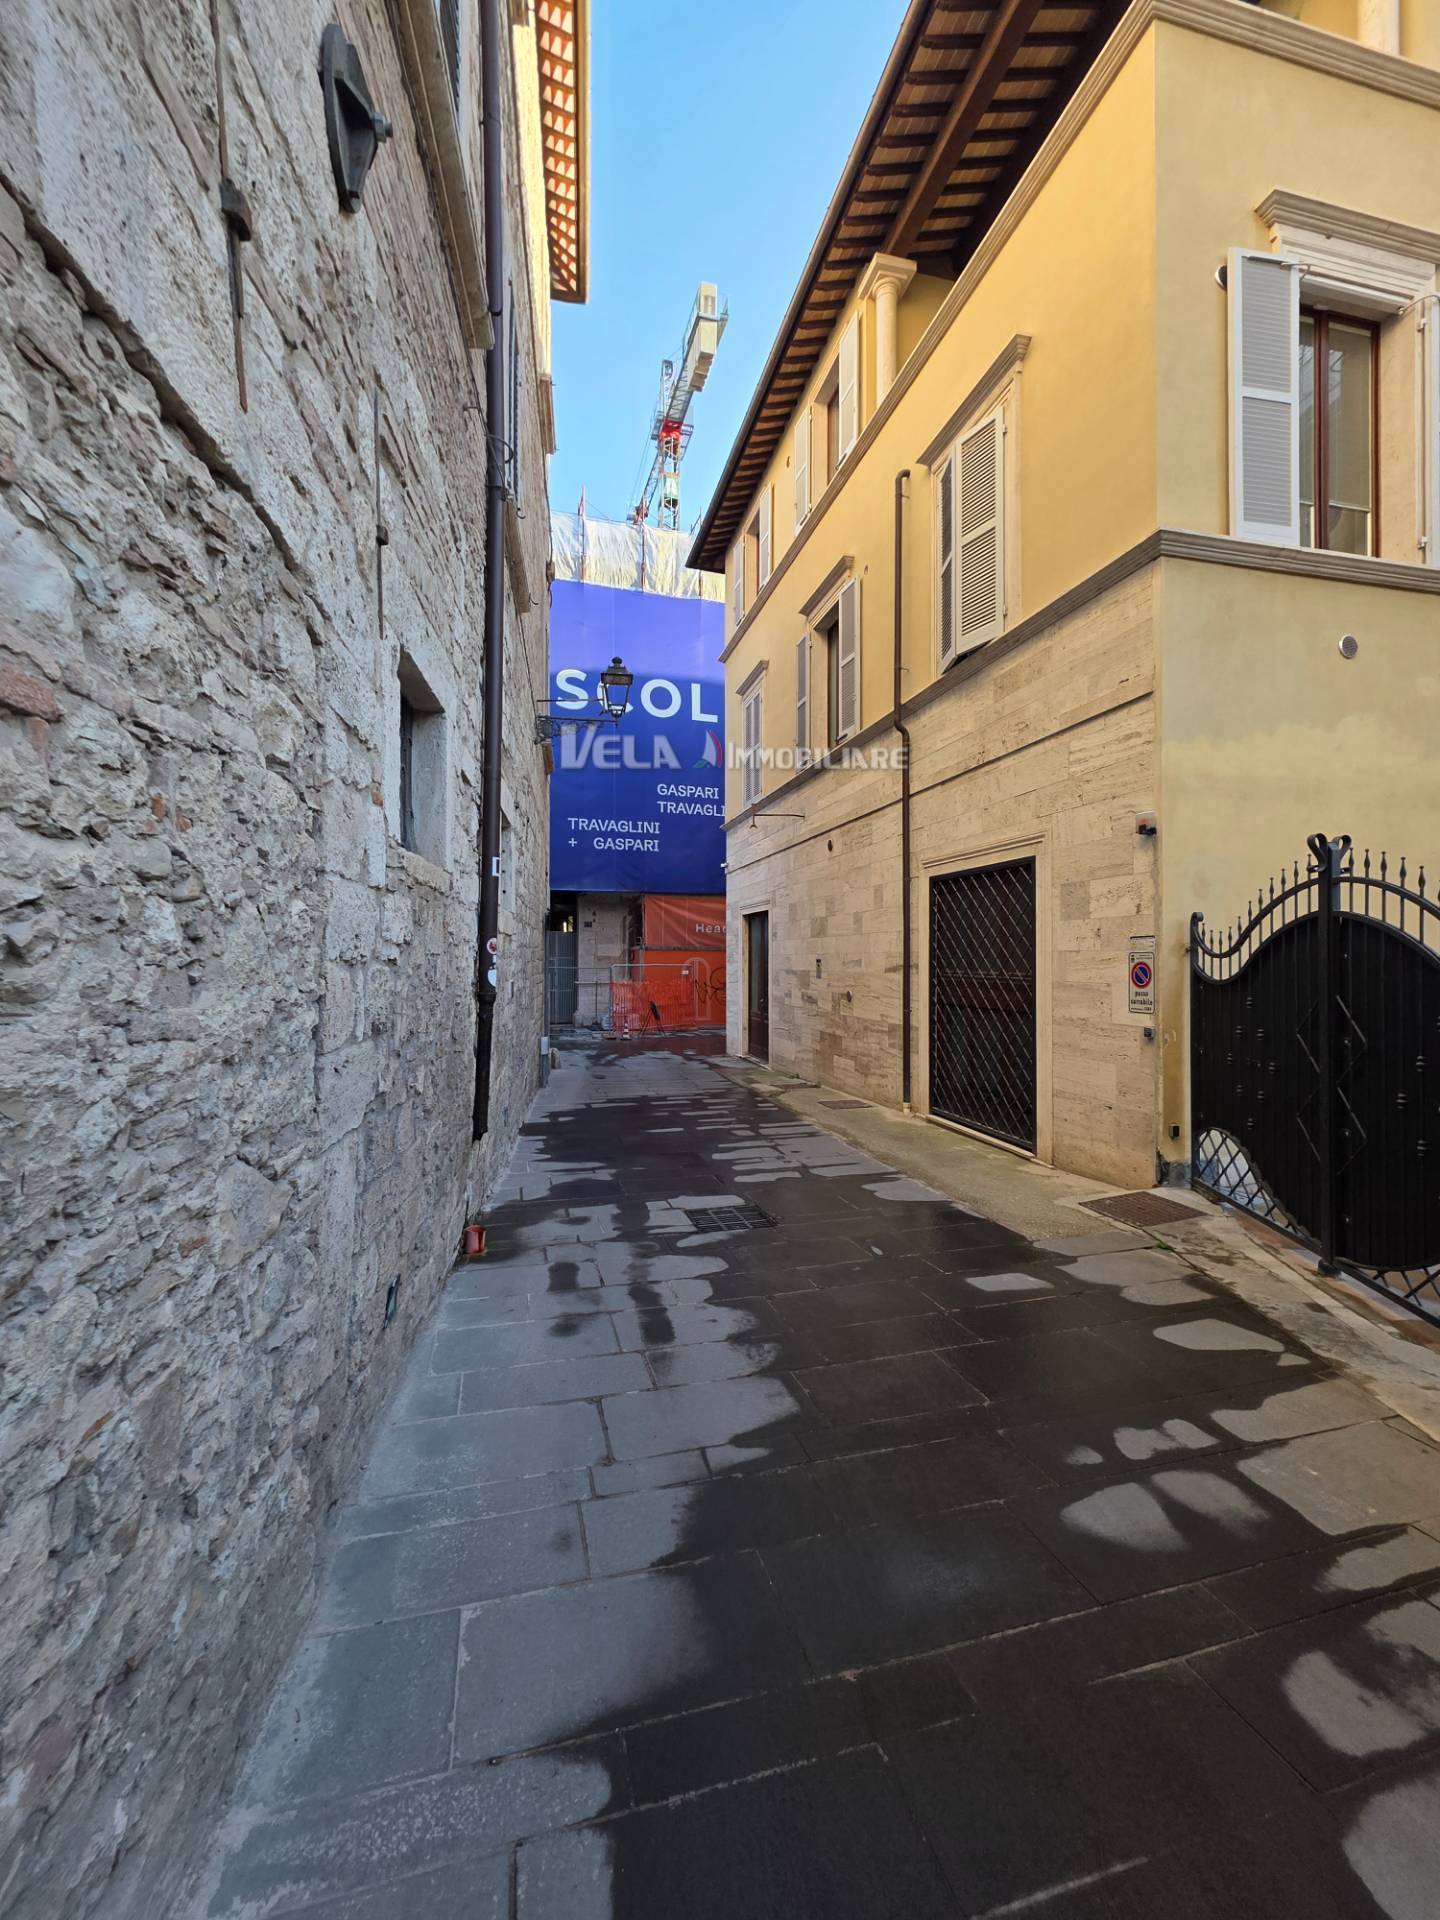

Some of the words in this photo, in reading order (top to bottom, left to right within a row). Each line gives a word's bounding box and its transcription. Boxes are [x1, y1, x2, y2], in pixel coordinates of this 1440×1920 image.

[657, 783, 719, 800] GASPARI
[568, 818, 660, 835] TRAVAGLINI
[568, 838, 578, 848] +
[593, 837, 660, 852] GASPARI
